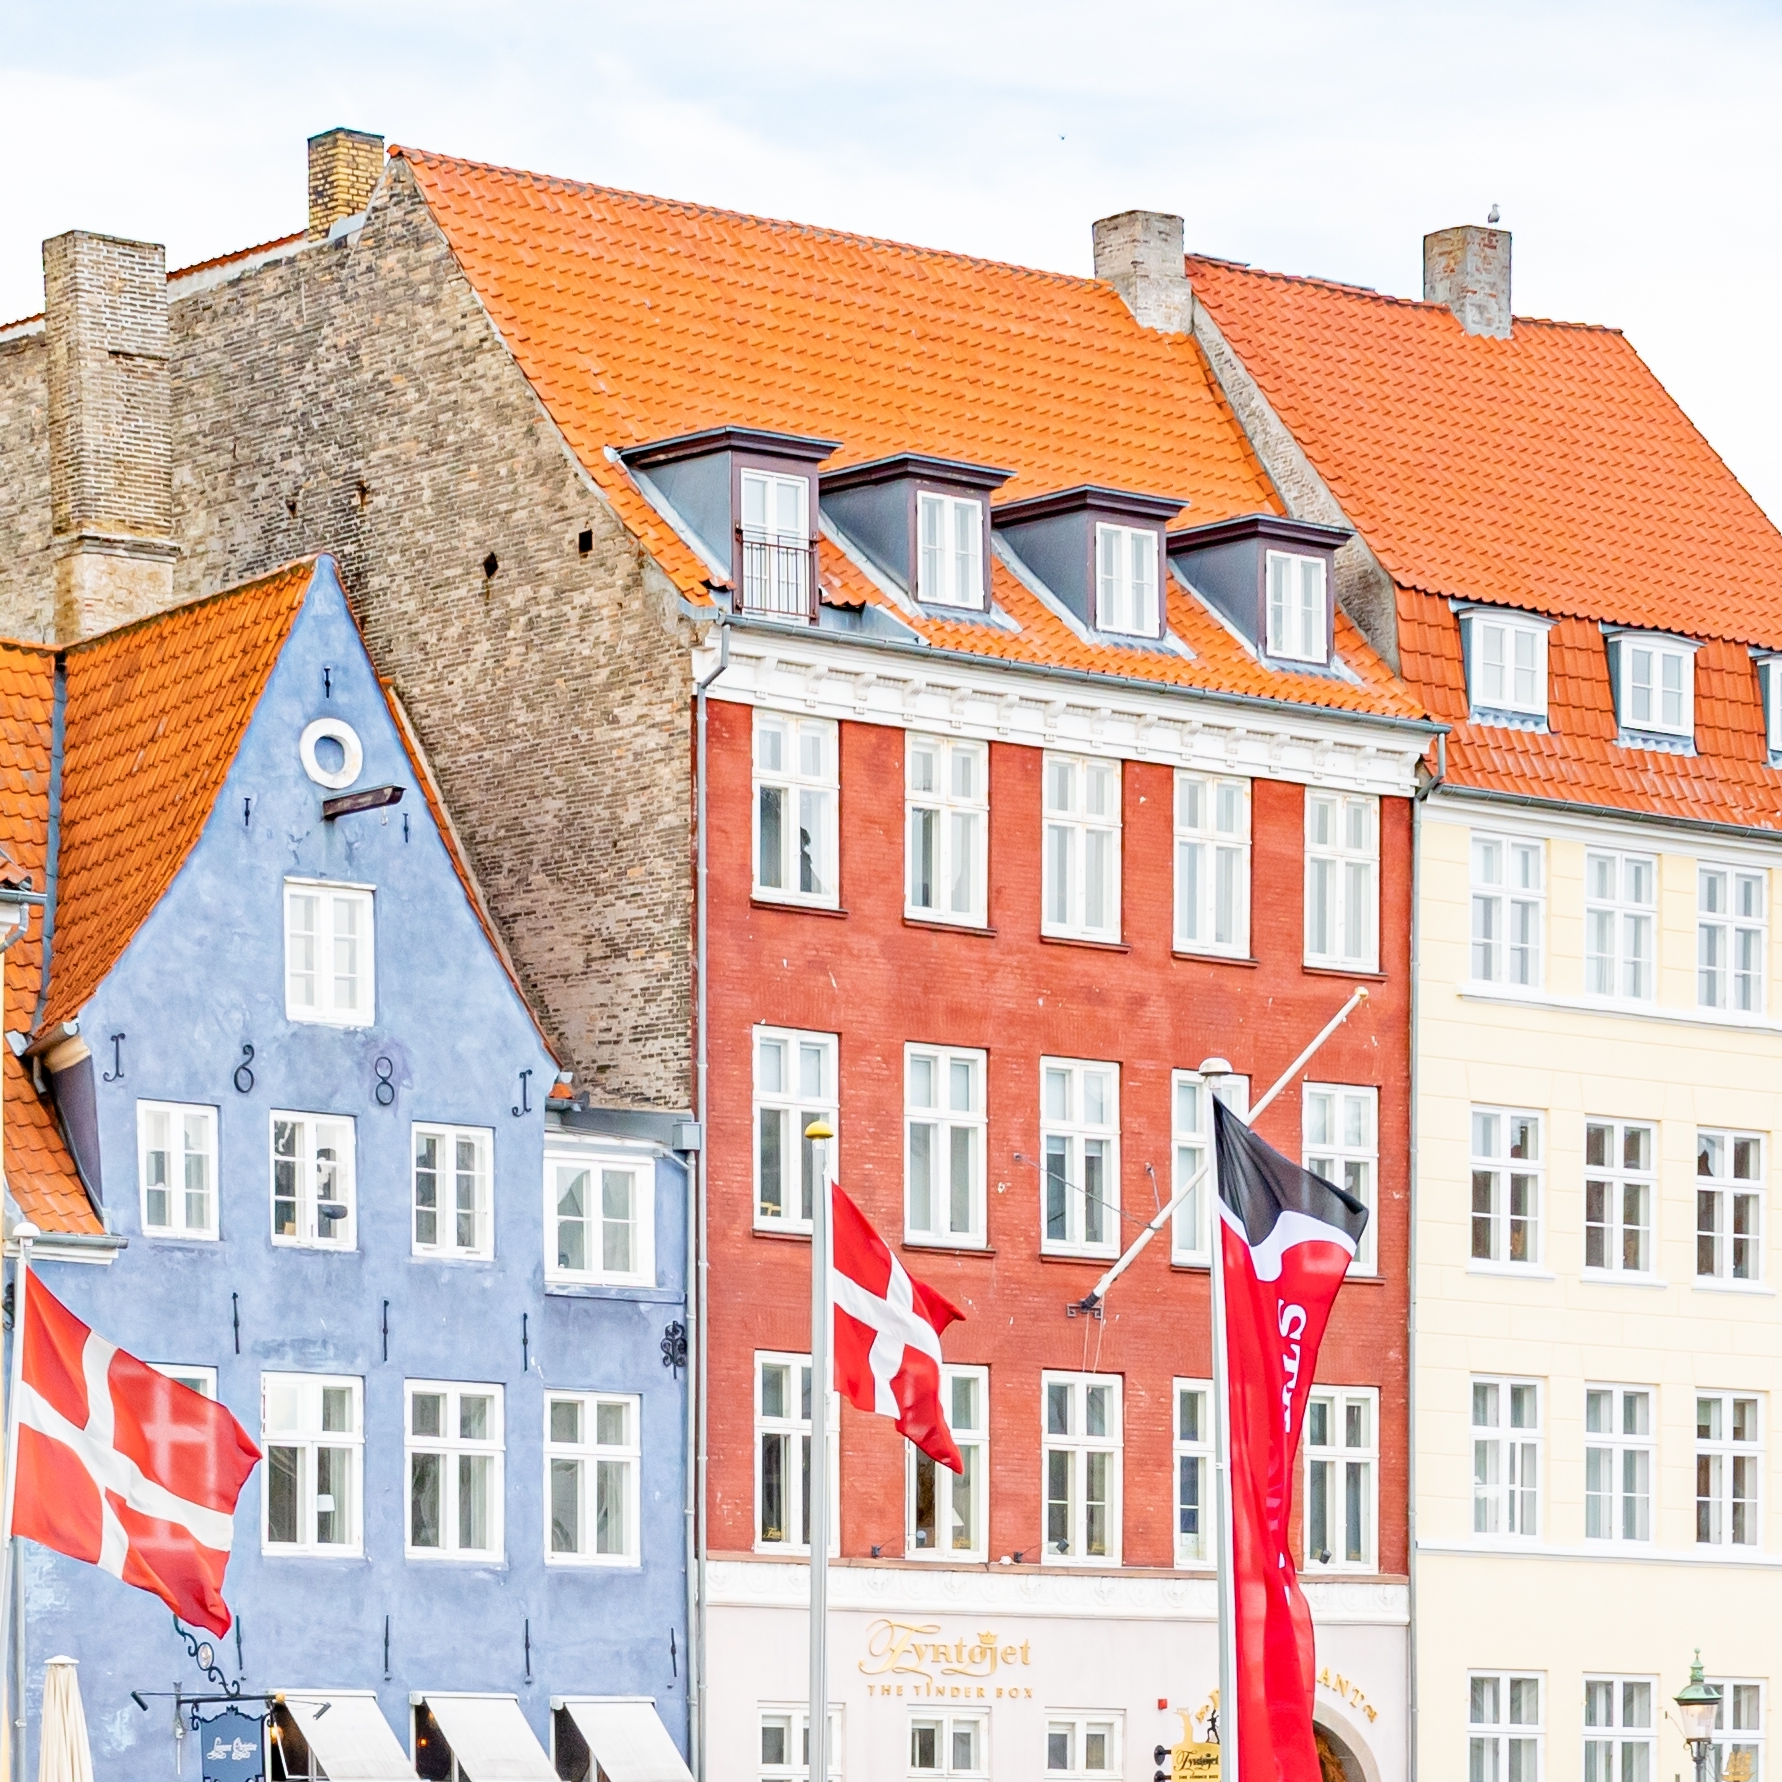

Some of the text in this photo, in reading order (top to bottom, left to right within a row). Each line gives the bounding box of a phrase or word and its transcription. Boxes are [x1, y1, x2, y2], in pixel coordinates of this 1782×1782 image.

[867, 1682, 1033, 1699] THE TINDER BOX
